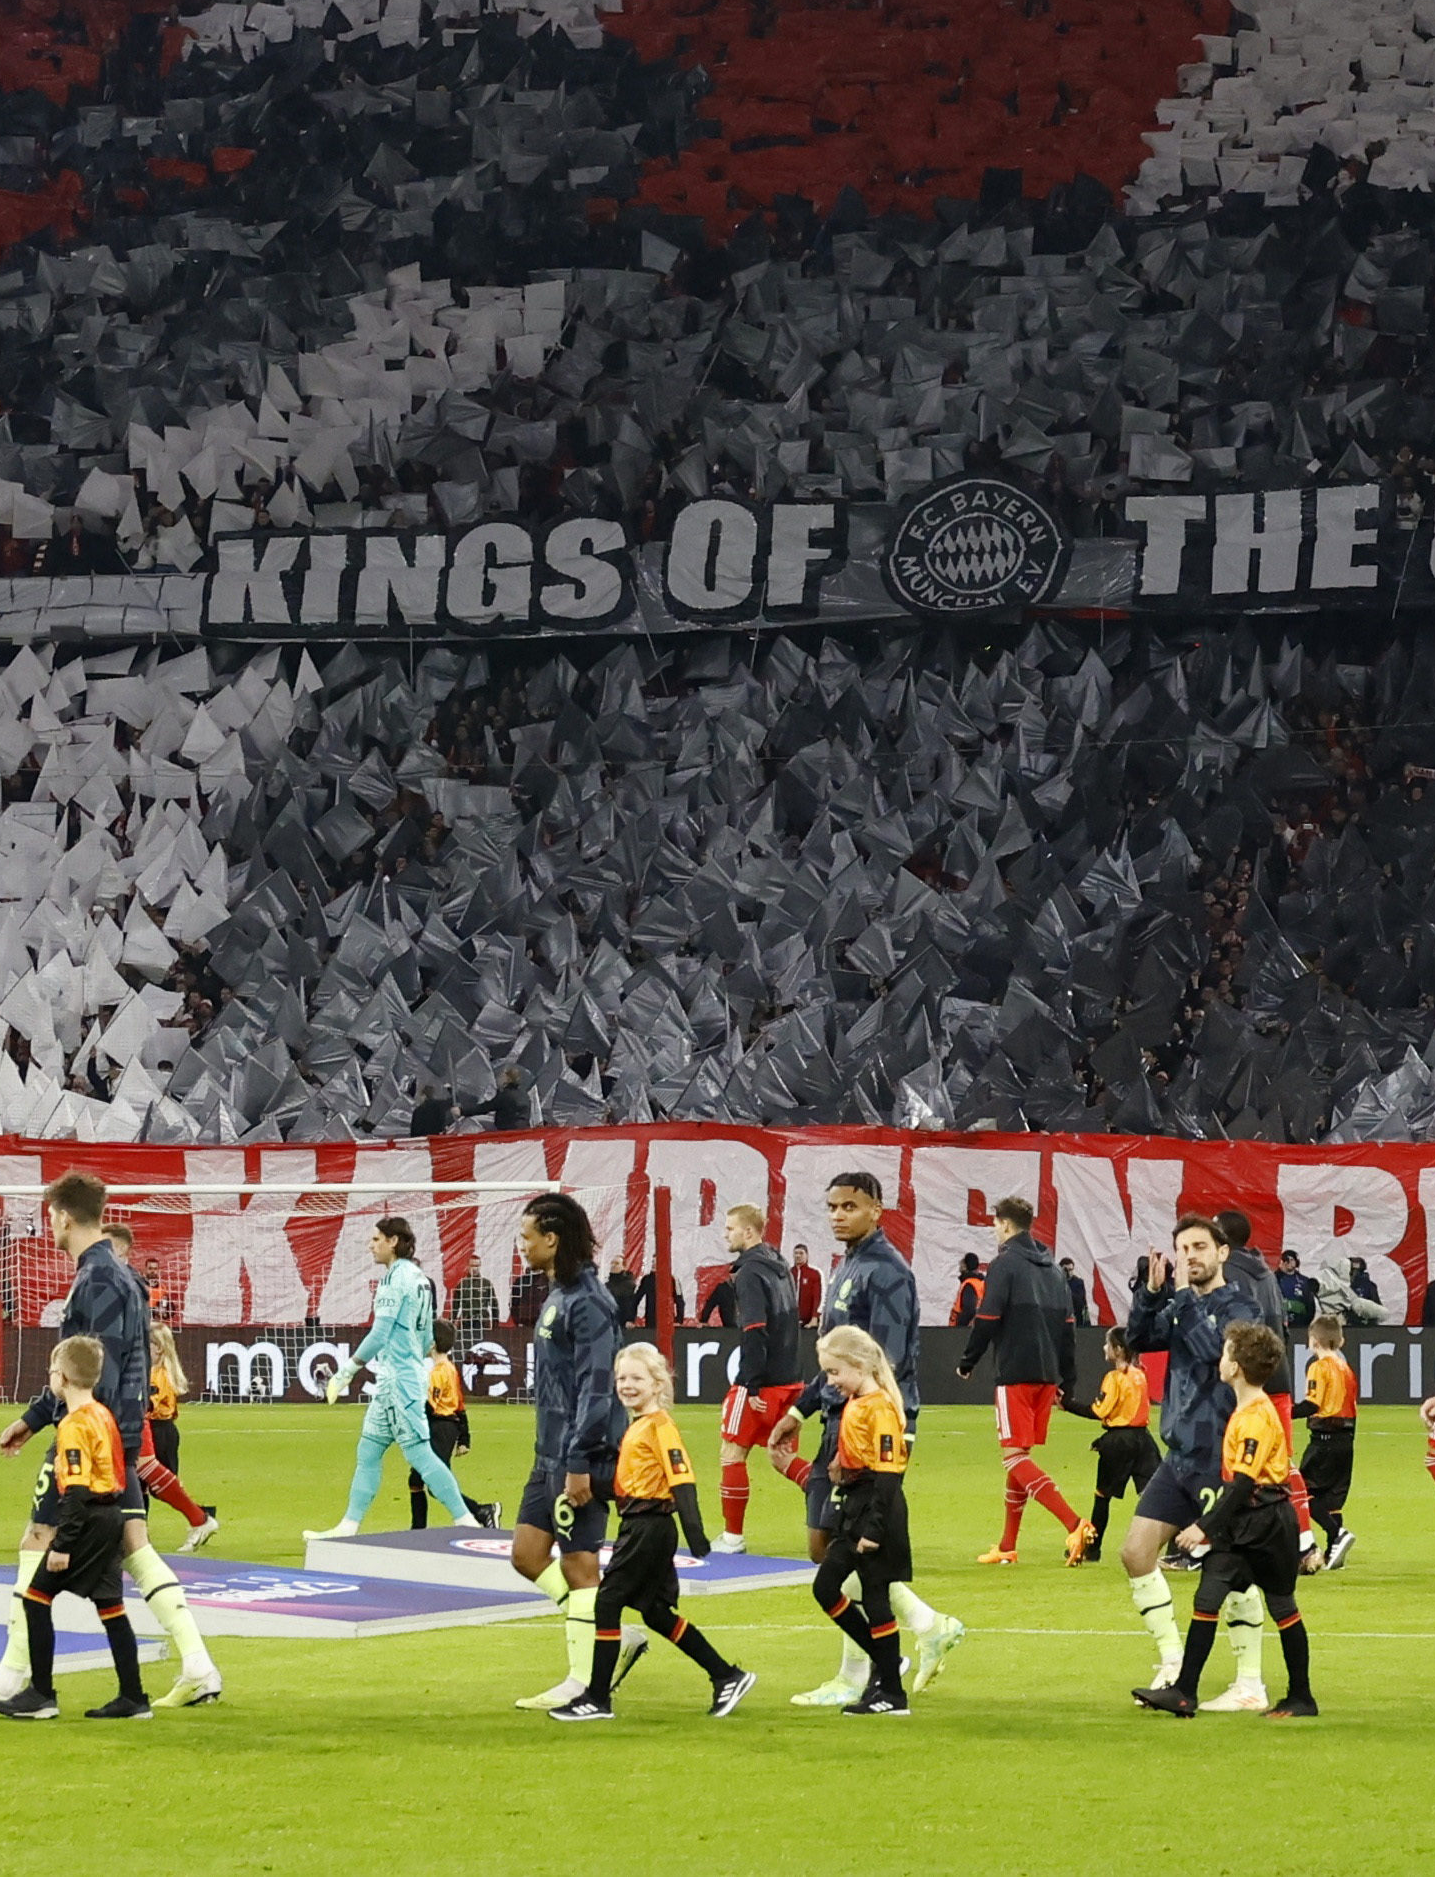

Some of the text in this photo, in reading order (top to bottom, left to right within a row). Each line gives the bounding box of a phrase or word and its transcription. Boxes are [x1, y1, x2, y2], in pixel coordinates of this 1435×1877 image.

[949, 490, 1048, 545] BAYERN
[207, 516, 627, 625] KINGS
[667, 499, 836, 610] OF
[1126, 483, 1381, 595] THE
[34, 1461, 55, 1497] 5
[553, 1493, 576, 1526] 6
